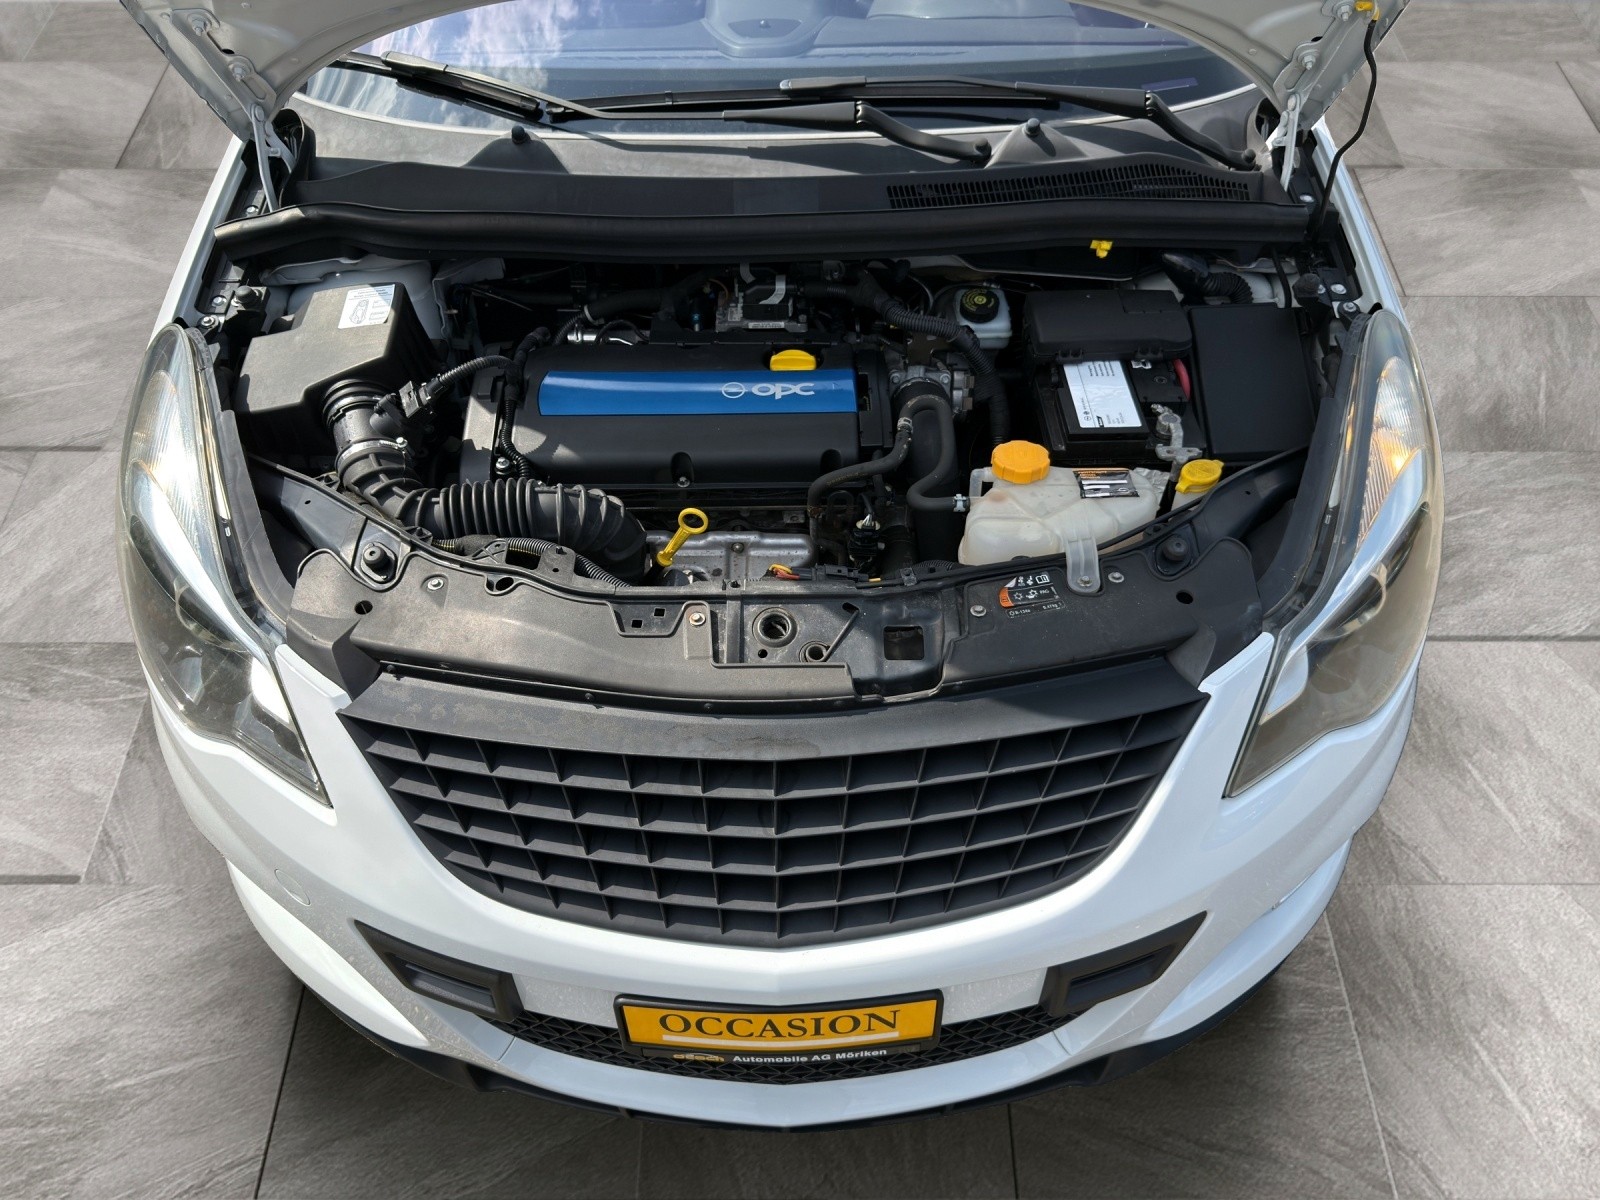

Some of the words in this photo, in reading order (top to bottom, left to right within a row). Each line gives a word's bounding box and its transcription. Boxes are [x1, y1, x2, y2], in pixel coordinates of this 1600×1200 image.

[659, 1010, 901, 1038] OCCASION
[733, 1055, 808, 1063] Automobile
[811, 1054, 831, 1062] AG
[835, 1049, 887, 1060] Möriken
